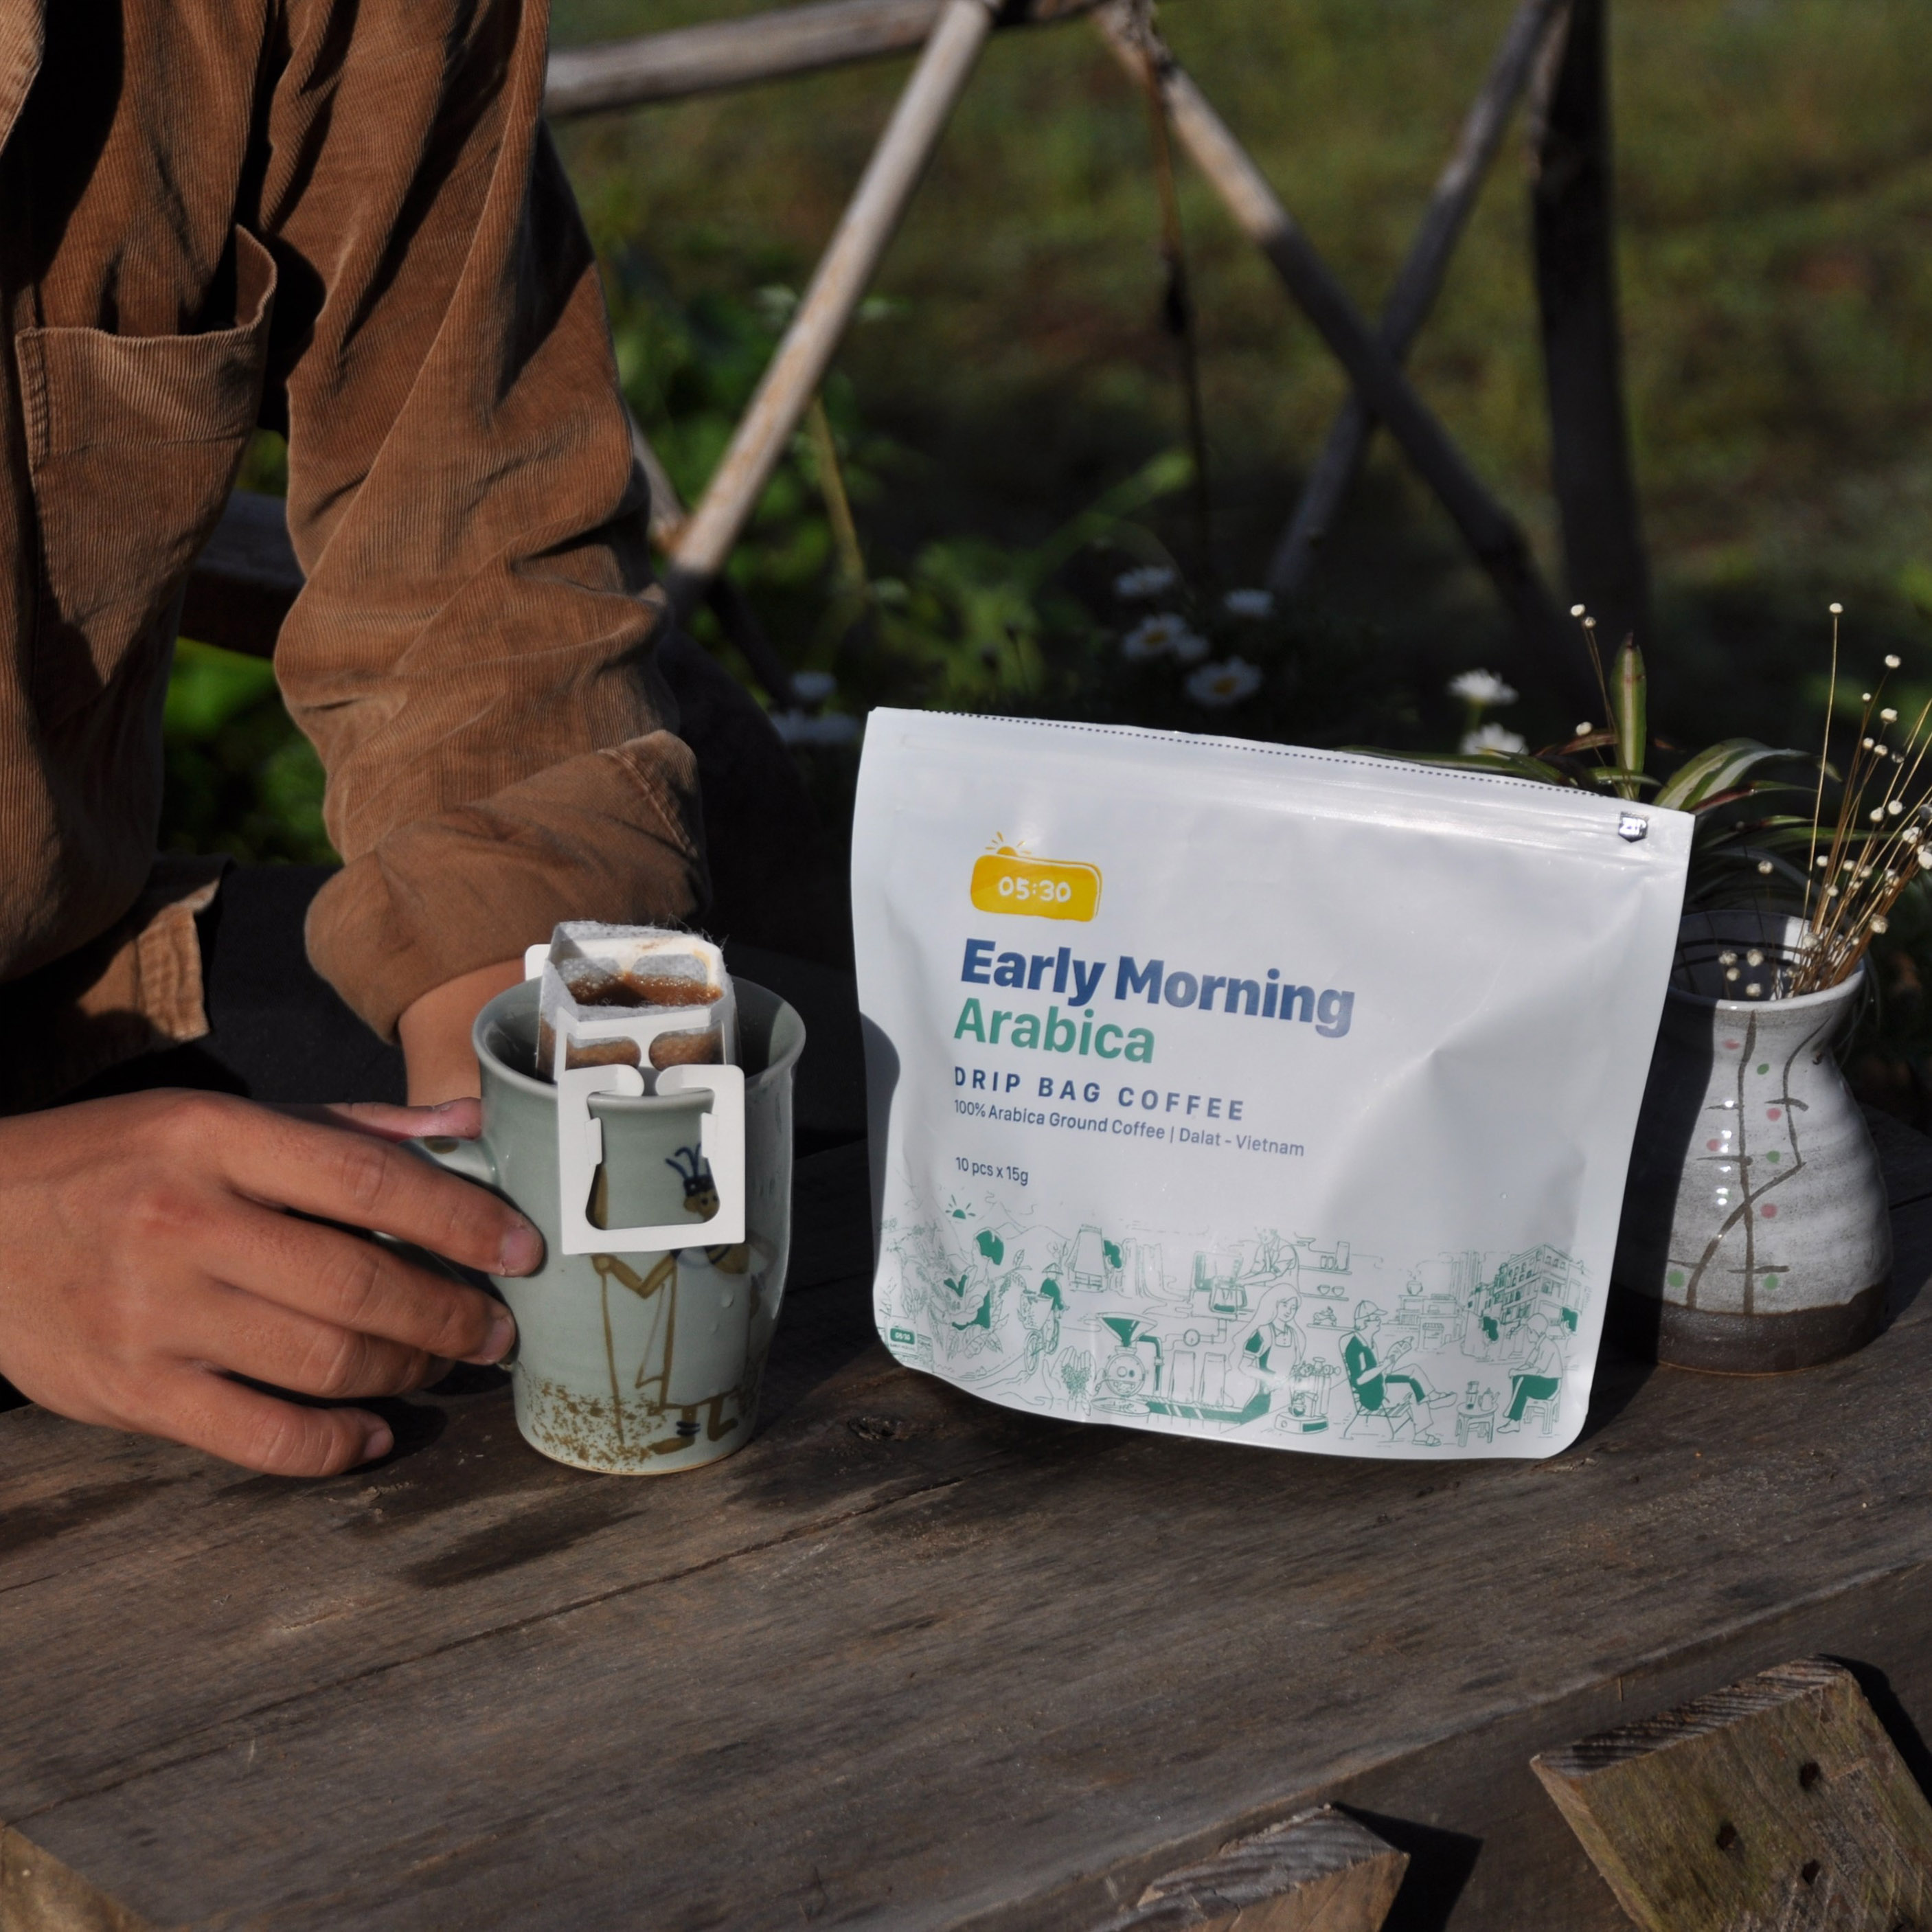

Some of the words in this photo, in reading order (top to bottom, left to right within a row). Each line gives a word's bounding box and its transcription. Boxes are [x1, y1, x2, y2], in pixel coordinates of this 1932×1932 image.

[998, 876, 1071, 903] 05:30
[961, 937, 1107, 1008] Early
[1114, 955, 1356, 1038] Morning
[953, 997, 1155, 1064] Arabica
[954, 1065, 1021, 1093] DRIP
[1038, 1076, 1101, 1103] BAG
[1117, 1087, 1244, 1122] COFFEE
[954, 1099, 986, 1118] 100%
[988, 1104, 1045, 1125] Arabica
[1049, 1111, 1109, 1133] Ground
[1112, 1120, 1165, 1139] Coffee
[1179, 1127, 1221, 1147] Dalat
[1236, 1134, 1305, 1157] Vietnam
[955, 1157, 968, 1172] 10
[971, 1161, 994, 1177] pcs
[996, 1167, 1004, 1179] x
[1005, 1166, 1030, 1187] 15g
